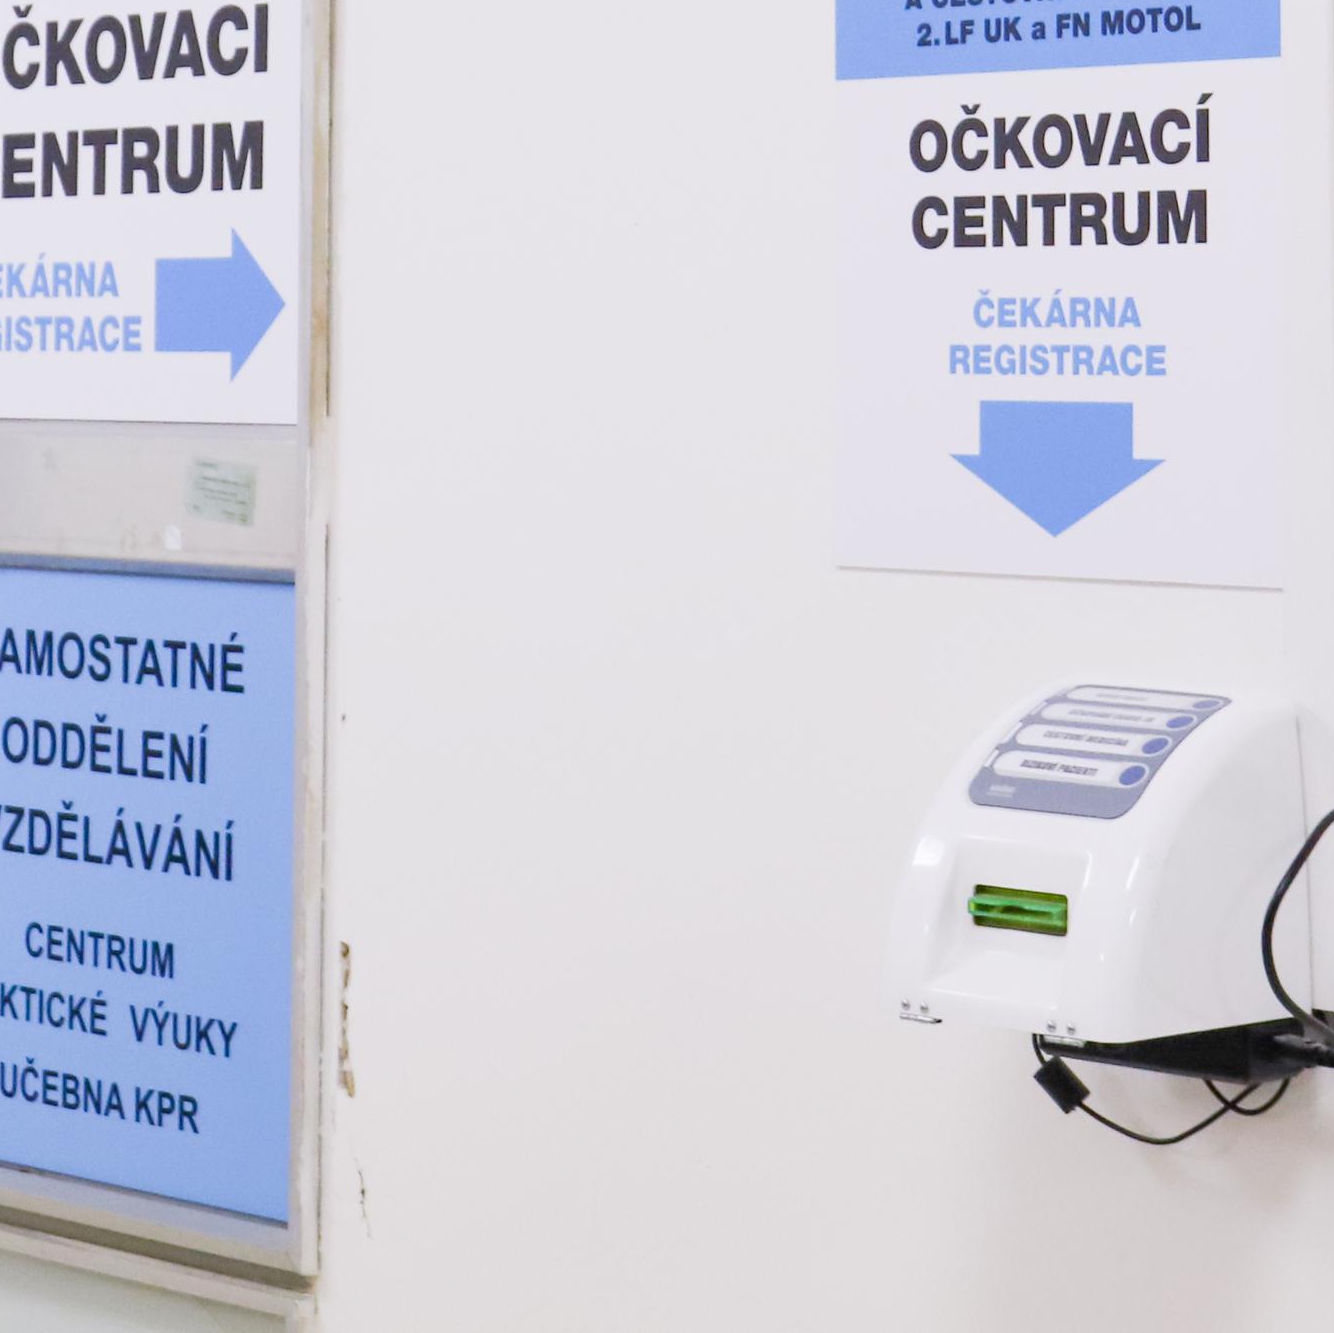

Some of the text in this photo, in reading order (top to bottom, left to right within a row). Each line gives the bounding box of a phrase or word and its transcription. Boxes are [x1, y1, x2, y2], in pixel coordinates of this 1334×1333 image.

[984, 16, 1023, 43] UK
[1032, 21, 1046, 40] a
[1056, 12, 1090, 39] FN
[1101, 5, 1202, 35] MOTOL
[909, 92, 1213, 173] OČKOVACÍ
[912, 189, 1208, 249] CENTRUM
[973, 289, 1142, 328] ČEKÁRNA
[949, 344, 1167, 376] REGISTRACE
[1, 713, 209, 785] ODDĚLENÍ
[25, 922, 175, 979] CENTRUM
[130, 1000, 238, 1059] VÝUKY
[0, 1058, 200, 1134] UČEBNA KPR
